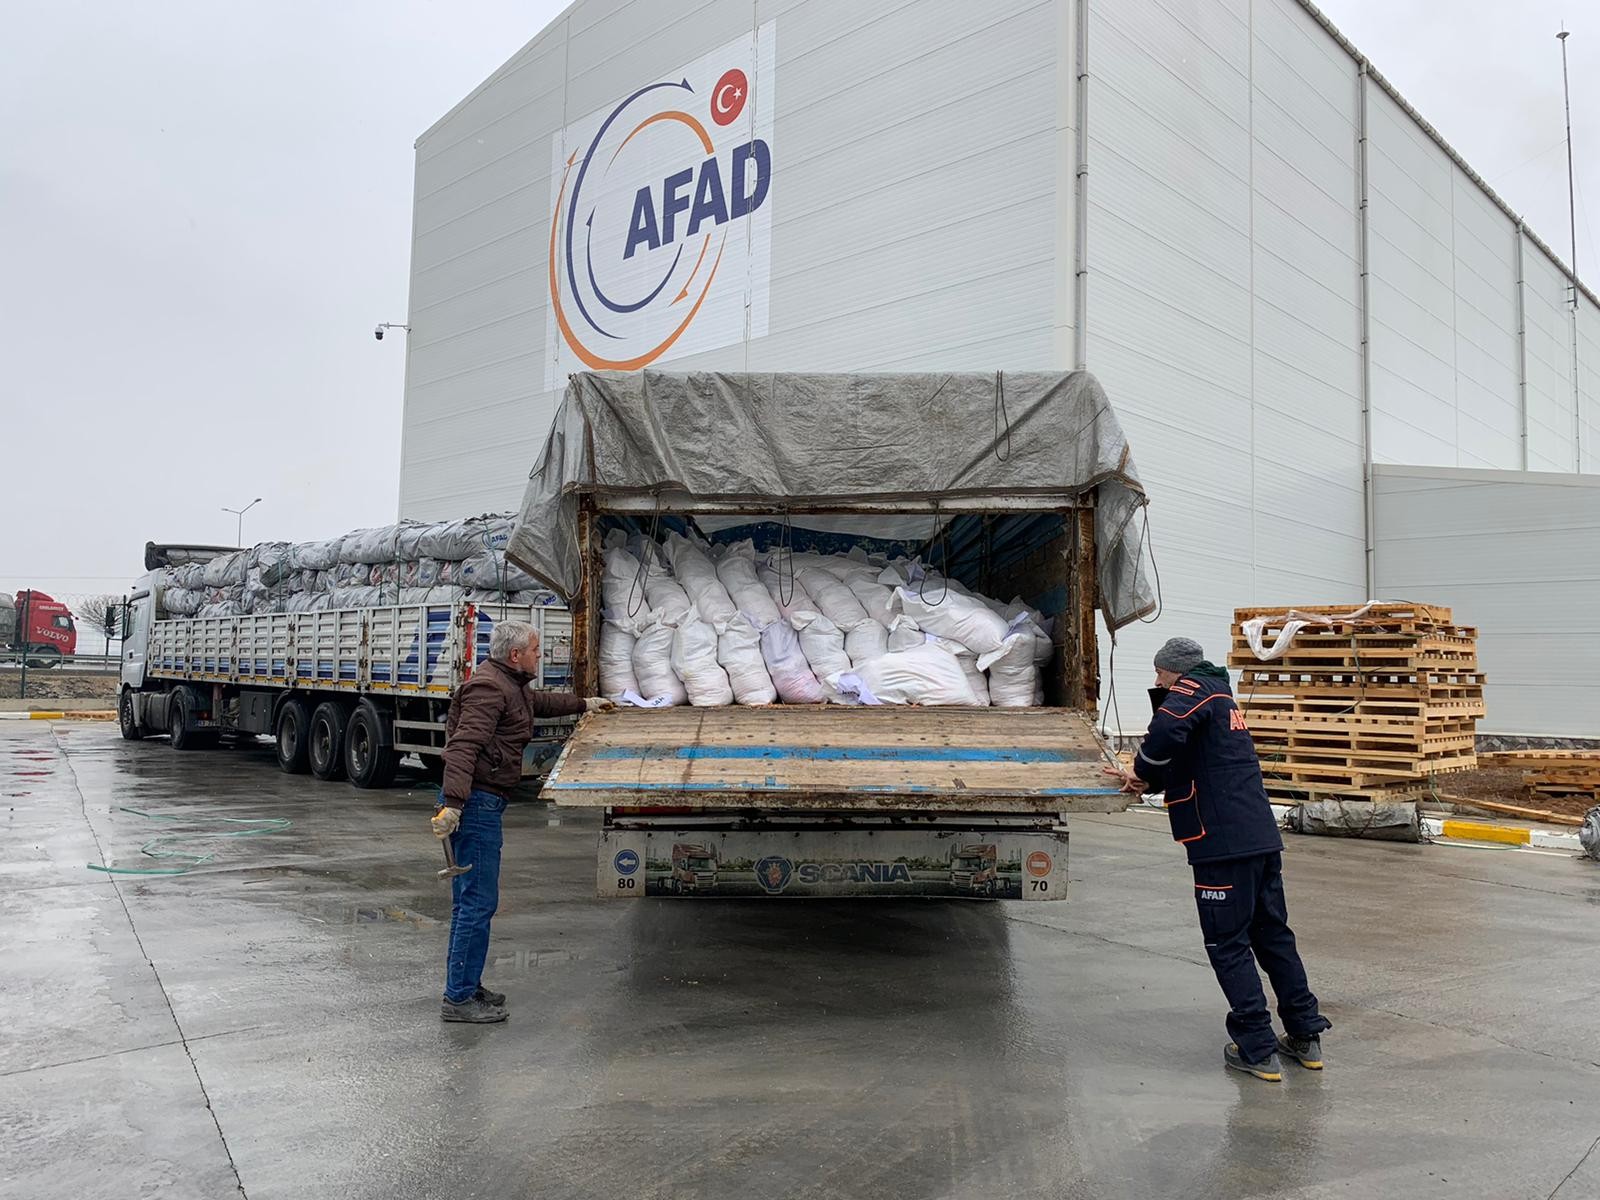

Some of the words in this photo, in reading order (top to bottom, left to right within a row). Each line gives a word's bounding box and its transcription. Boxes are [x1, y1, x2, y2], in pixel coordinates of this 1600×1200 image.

[623, 139, 771, 260] AFAD
[36, 626, 69, 642] VOLVO
[1230, 709, 1248, 730] AF
[799, 863, 913, 884] SCANIA
[617, 878, 635, 889] 80
[1030, 880, 1048, 891] 70
[1201, 890, 1226, 900] AFAD
